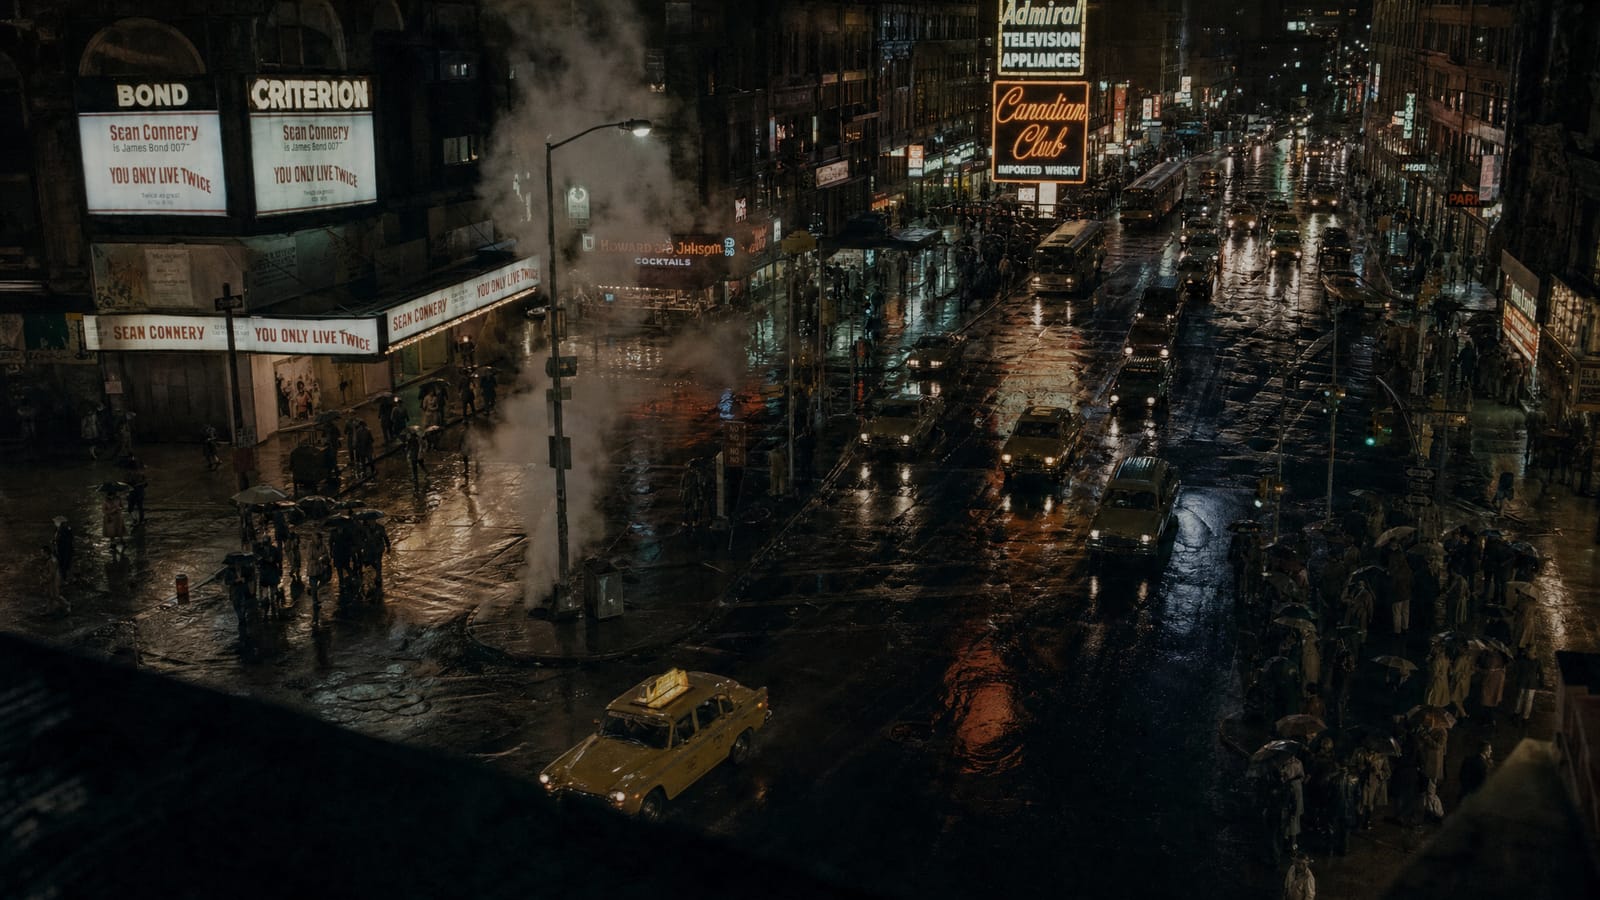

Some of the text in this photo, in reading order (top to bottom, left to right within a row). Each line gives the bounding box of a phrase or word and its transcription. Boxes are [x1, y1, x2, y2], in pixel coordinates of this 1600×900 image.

[1002, 0, 1083, 25] Admiral
[1003, 32, 1080, 47] TELEVISION
[1002, 53, 1080, 67] APPLIANCES
[116, 83, 189, 107] BOND
[251, 79, 368, 110] CRITERION
[997, 86, 1087, 123] Canadian
[110, 124, 198, 141] Sean Connery
[309, 124, 349, 141] Connery
[1013, 124, 1068, 160] Club
[113, 143, 121, 153] is
[122, 143, 147, 153] James
[149, 143, 168, 153] Bond
[291, 142, 311, 152] James
[109, 167, 212, 194] YOU ONLY LIVE TWICE
[274, 164, 358, 188] YOU ONLY LIVE TWICE
[998, 165, 1080, 176] IMPORTED WHISKY
[634, 257, 692, 266] COCKTAILS
[393, 312, 413, 331] SEAN
[414, 298, 448, 323] CONNERY
[477, 281, 490, 298] YOU
[491, 274, 506, 291] ONLY
[507, 270, 520, 287] LIVE
[114, 325, 146, 340] SEAN
[149, 325, 205, 340] CONNERY
[255, 327, 277, 342] YOU
[281, 328, 308, 343] ONLY
[313, 330, 337, 344] LIVE
[339, 329, 370, 350] TWICE
